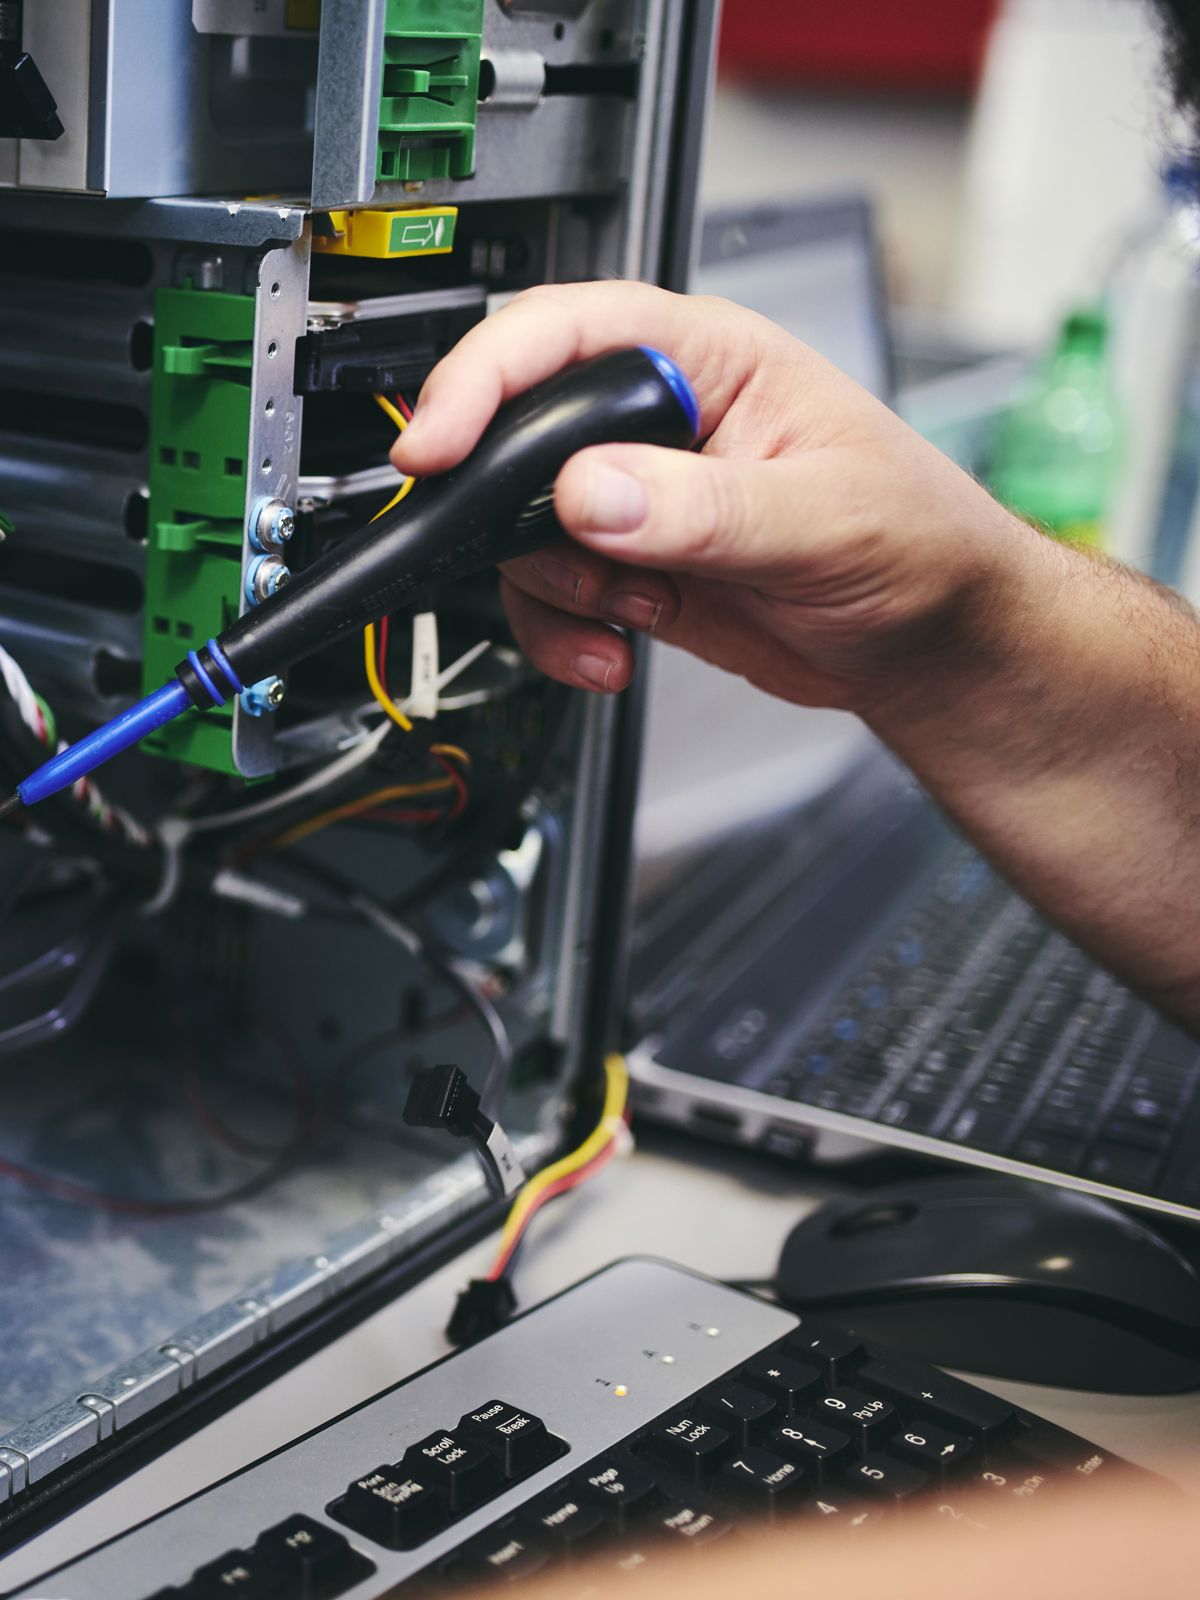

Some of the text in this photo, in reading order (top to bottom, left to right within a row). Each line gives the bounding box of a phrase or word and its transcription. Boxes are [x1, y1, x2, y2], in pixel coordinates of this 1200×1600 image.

[824, 1398, 847, 1410] 9
[853, 1401, 884, 1420] Pg Up
[471, 1404, 504, 1422] Pause
[499, 1417, 530, 1434] Break
[665, 1419, 694, 1436] Num
[681, 1424, 711, 1443] Lock
[781, 1428, 803, 1440] 8
[421, 1436, 455, 1457] Scroll
[904, 1433, 926, 1446] 6
[436, 1447, 468, 1465] Lock
[732, 1460, 755, 1475] 7
[762, 1463, 796, 1485] Home
[860, 1465, 885, 1480] 5
[588, 1467, 619, 1487] Page
[981, 1471, 1007, 1486] 3
[541, 1502, 579, 1527] Home
[816, 1500, 840, 1515] 4
